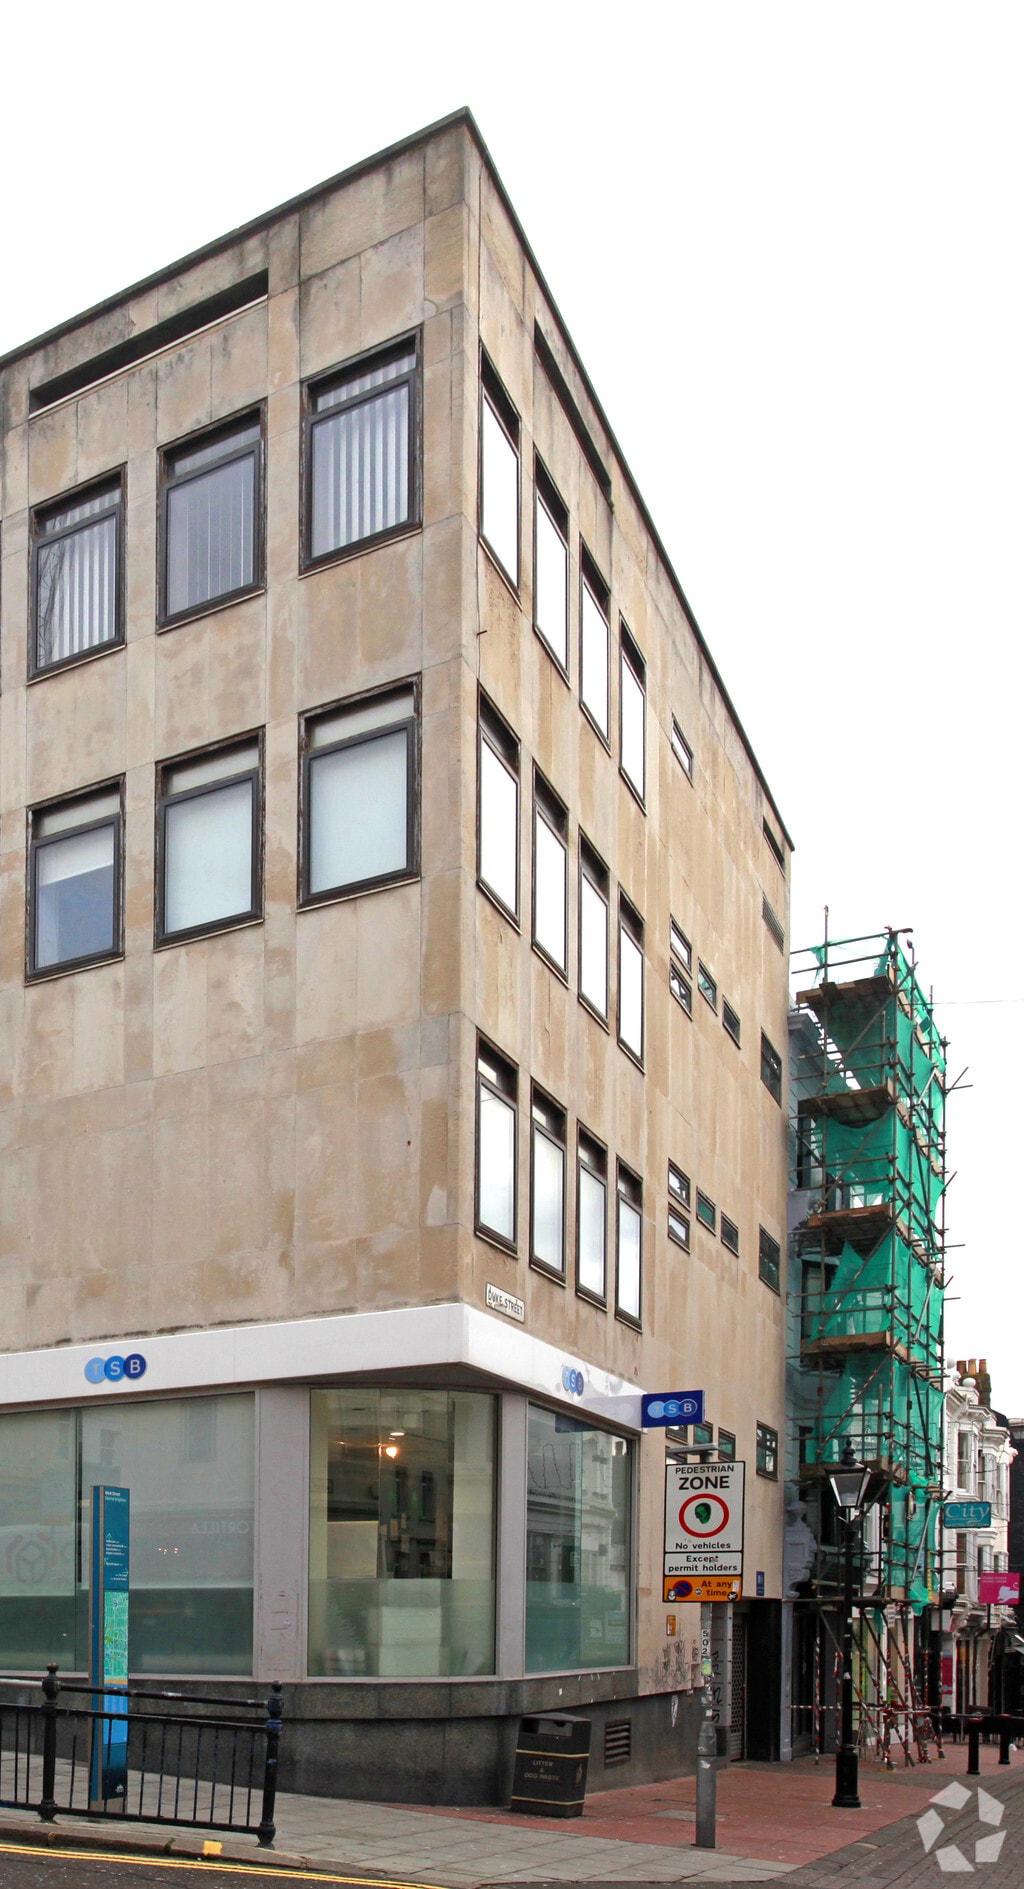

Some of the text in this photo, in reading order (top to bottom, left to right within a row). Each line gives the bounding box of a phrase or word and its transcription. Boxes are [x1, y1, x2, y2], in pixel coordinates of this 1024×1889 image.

[487, 1290, 523, 1317] DUKE STREET
[90, 1357, 143, 1380] TSB
[563, 1368, 583, 1393] TSB
[650, 1401, 694, 1416] TSB
[675, 1464, 735, 1474] PEDESTRIAN
[678, 1476, 730, 1490] ZONE
[946, 1504, 990, 1523] City
[675, 1541, 731, 1550] No vehicles
[686, 1555, 719, 1563] Except
[668, 1563, 738, 1573] permit holders
[716, 1581, 732, 1590] any
[706, 1589, 727, 1597] time
